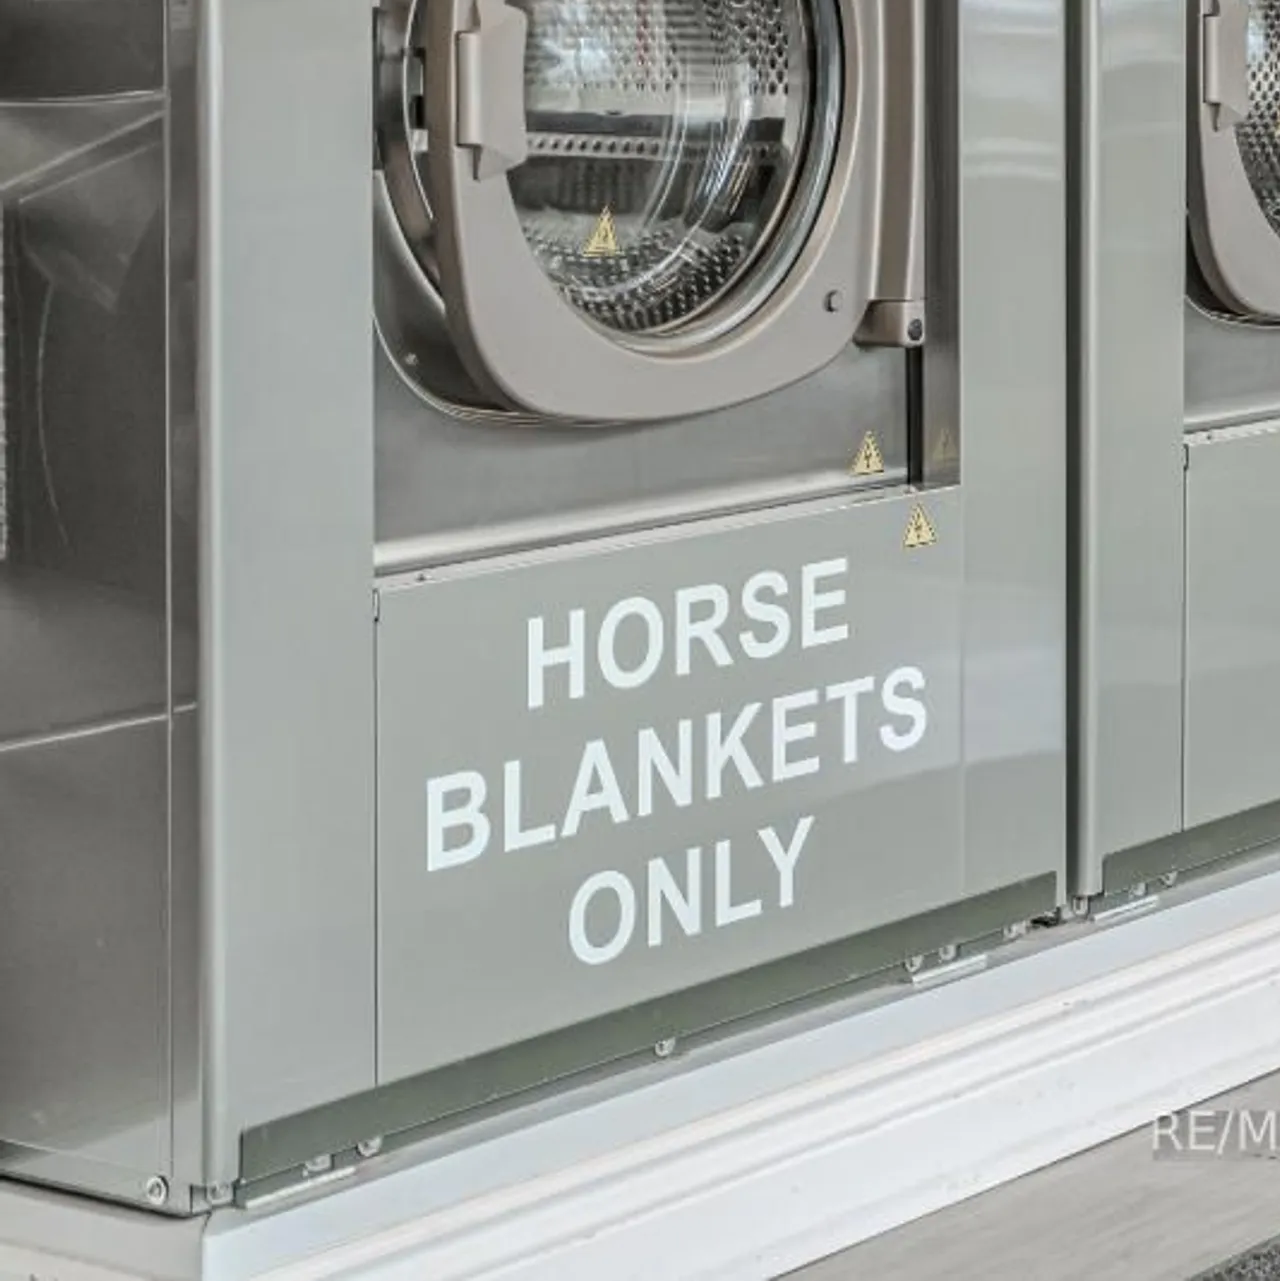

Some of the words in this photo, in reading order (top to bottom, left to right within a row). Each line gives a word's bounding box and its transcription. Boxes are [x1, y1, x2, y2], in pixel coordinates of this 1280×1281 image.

[527, 557, 850, 710] HORSE
[426, 665, 929, 872] BLANKETS
[568, 814, 816, 966] ONLY
